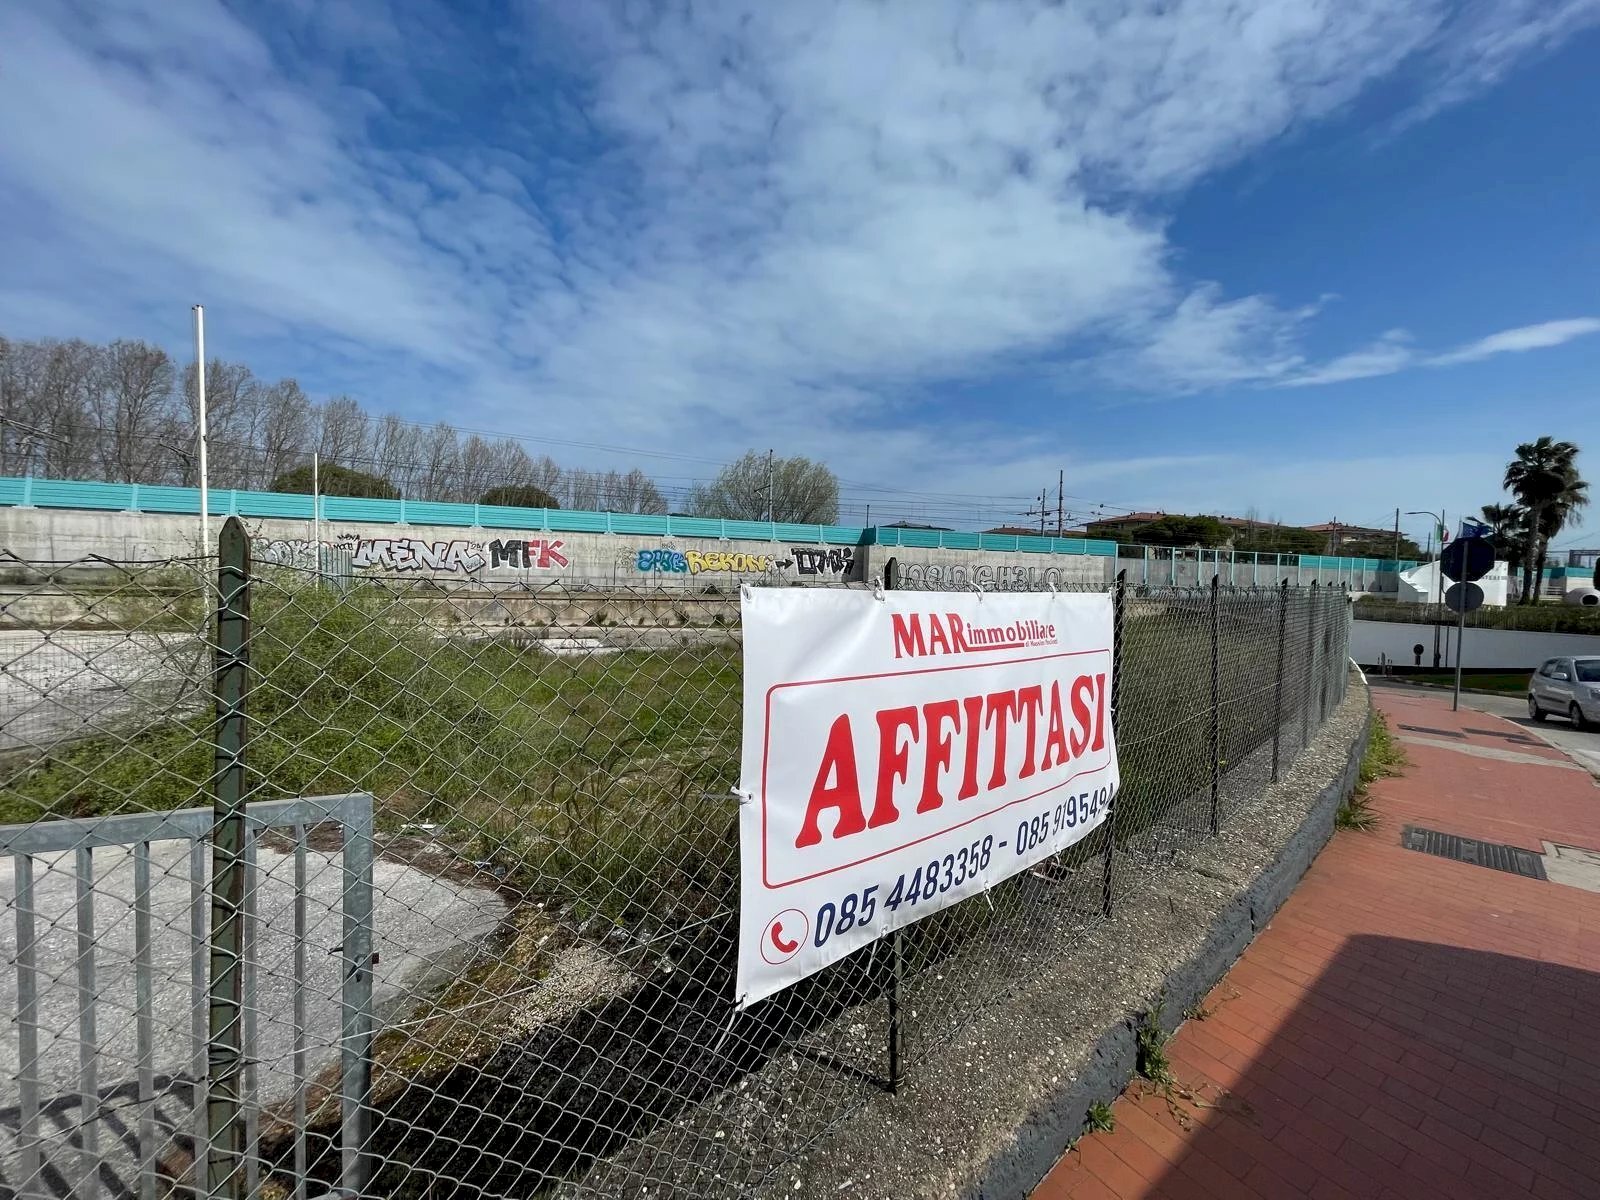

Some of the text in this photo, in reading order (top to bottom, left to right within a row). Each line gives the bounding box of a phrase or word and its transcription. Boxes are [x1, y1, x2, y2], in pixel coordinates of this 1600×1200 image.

[352, 539, 486, 573] MENA
[795, 673, 1106, 849] AFFITTASI
[814, 885, 879, 948] 085
[883, 834, 994, 912] 4483358
[1016, 811, 1050, 855] 085
